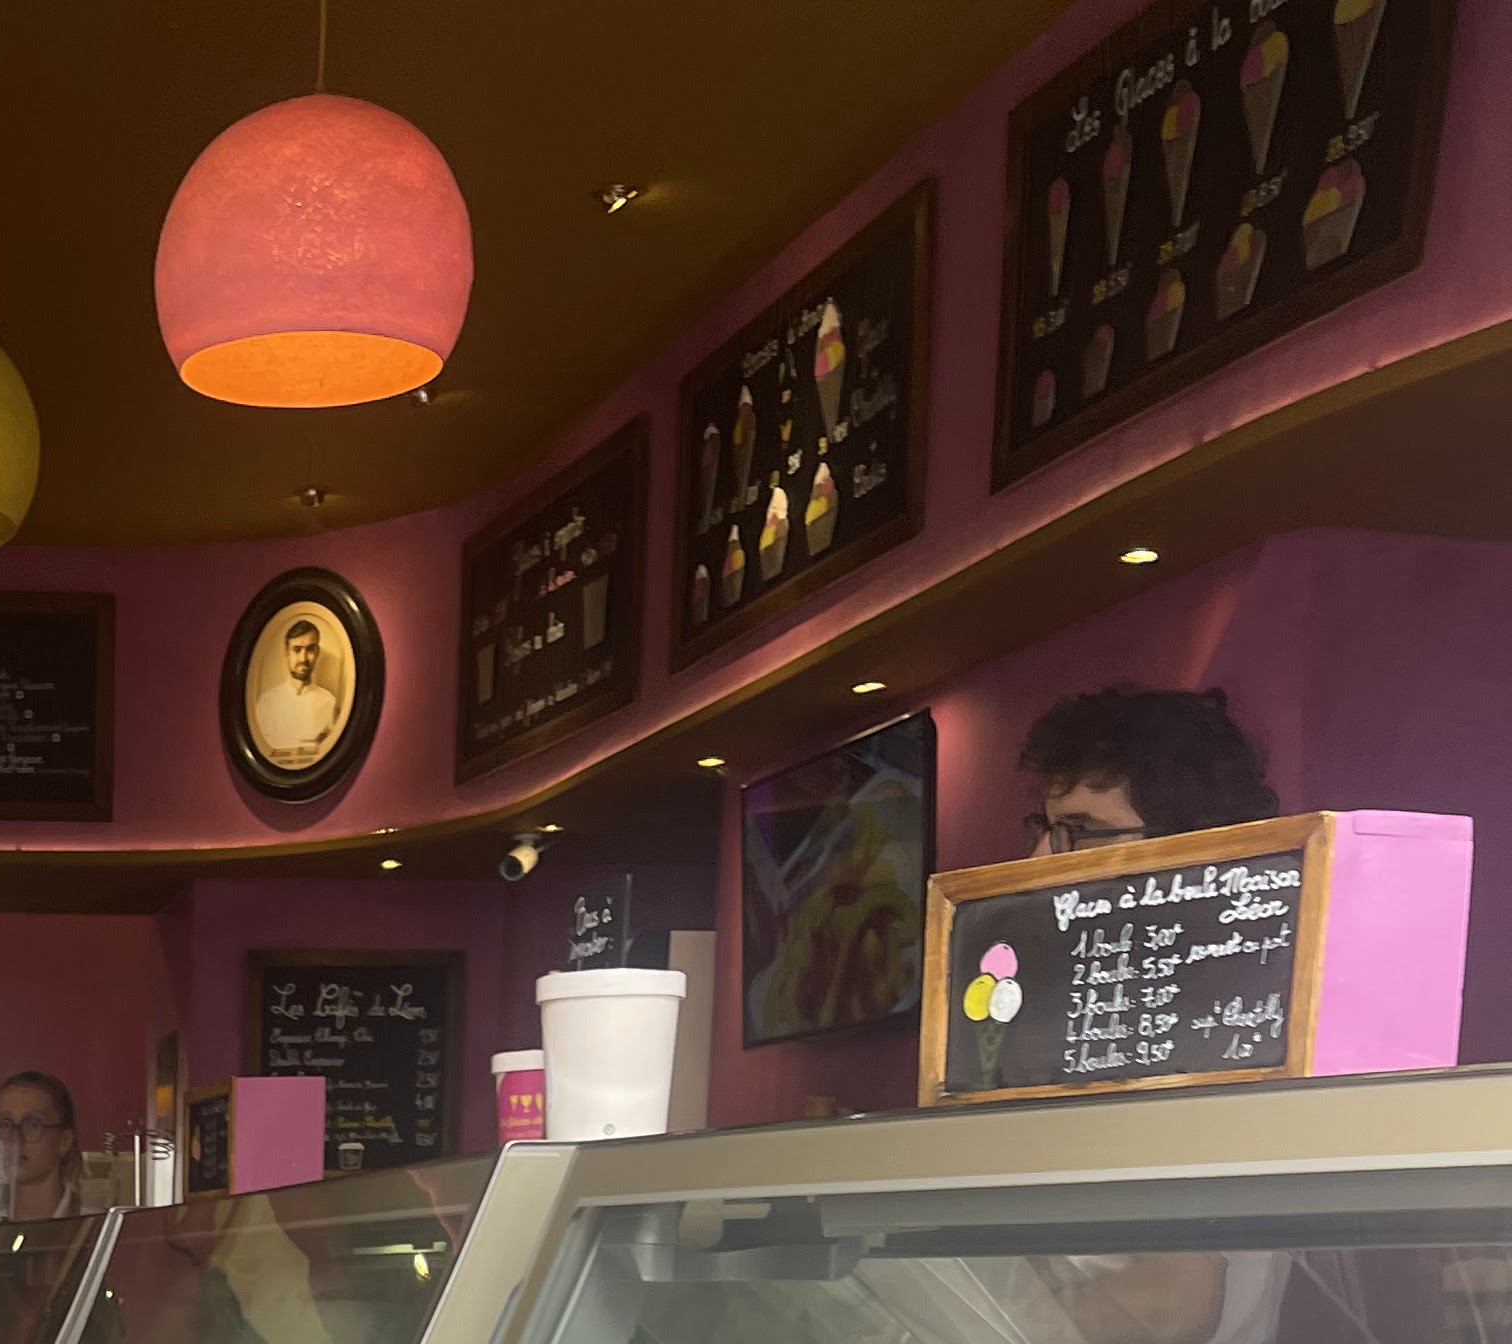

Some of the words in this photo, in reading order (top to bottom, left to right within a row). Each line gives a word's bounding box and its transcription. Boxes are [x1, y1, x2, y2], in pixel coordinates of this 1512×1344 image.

[1118, 884, 1137, 909] à
[1139, 876, 1167, 906] la
[1219, 866, 1301, 897] Maison
[1218, 892, 1289, 924] Léon
[1070, 930, 1087, 958] 1
[1072, 963, 1086, 985] 2
[1067, 992, 1083, 1018] 3
[1062, 1049, 1076, 1074] 5
